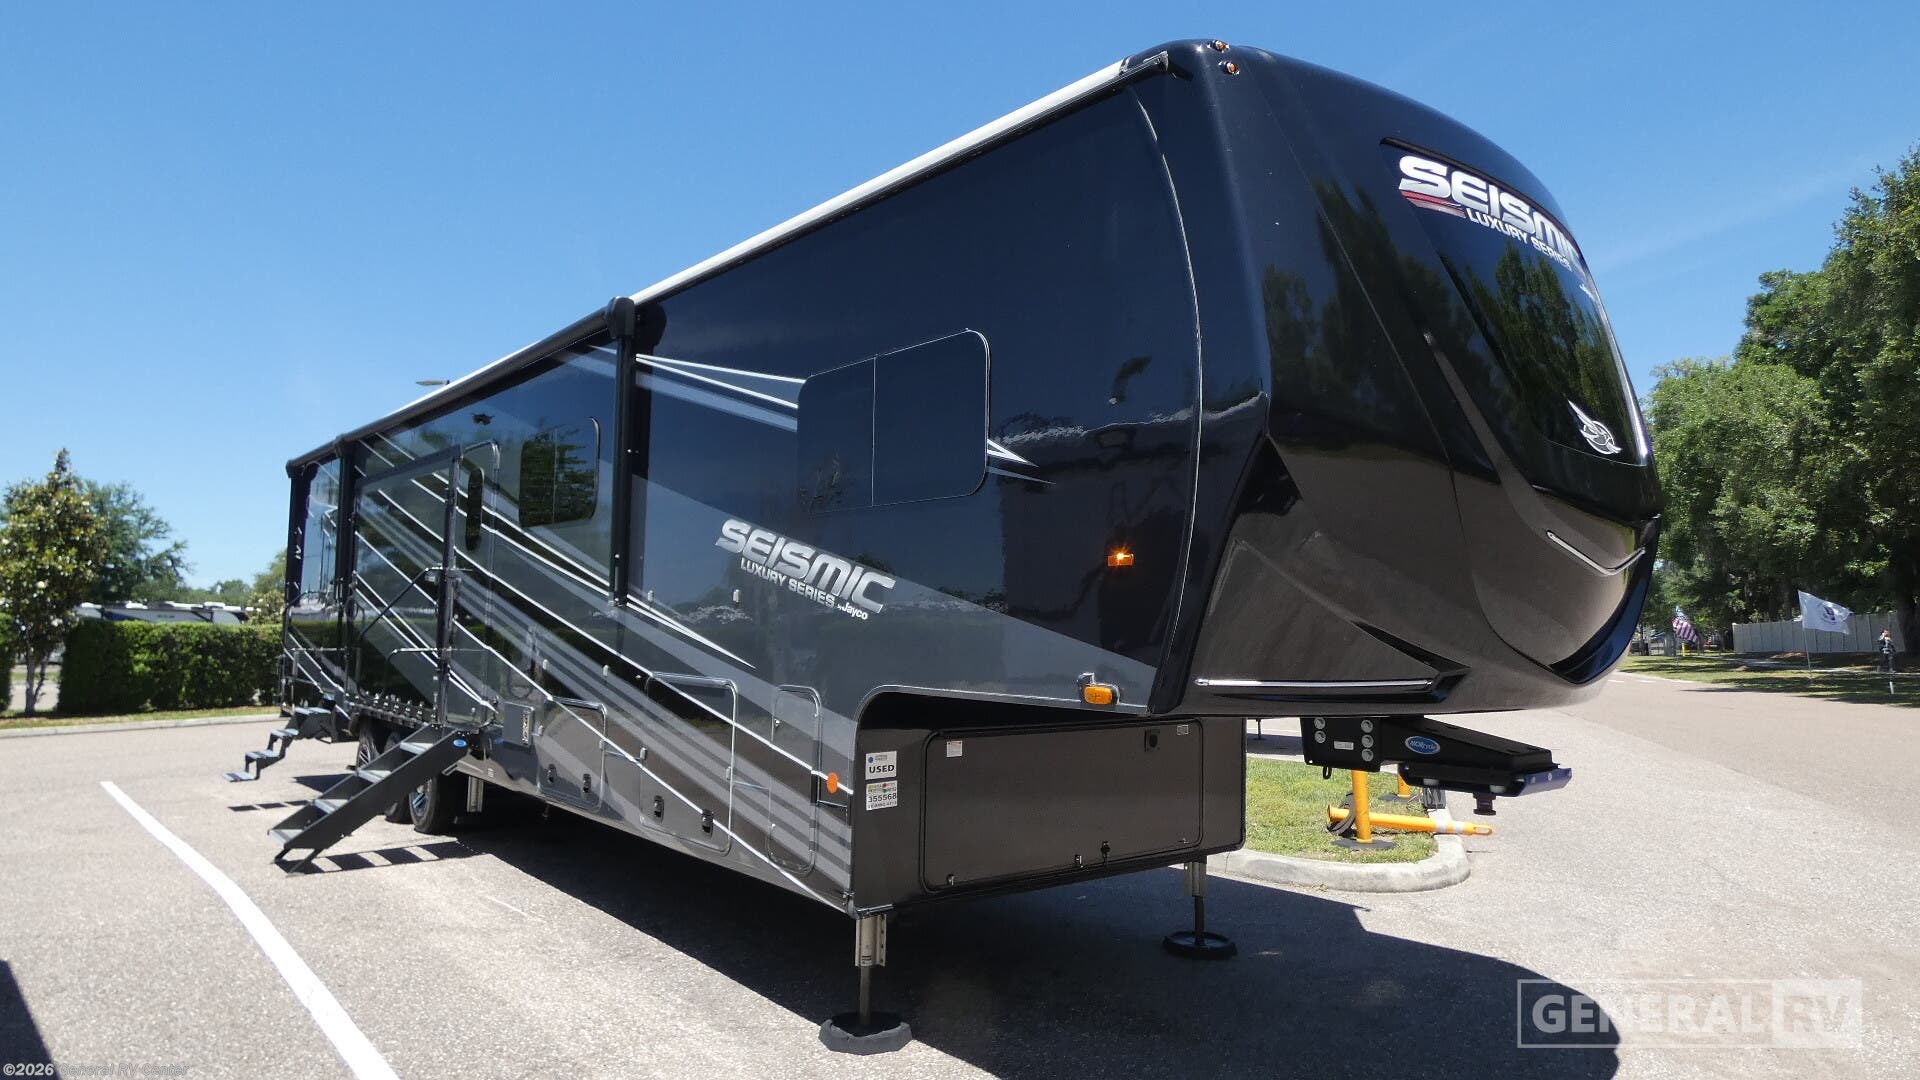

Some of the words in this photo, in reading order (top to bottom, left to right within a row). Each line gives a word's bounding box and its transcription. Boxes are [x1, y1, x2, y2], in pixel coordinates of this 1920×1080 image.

[1466, 208, 1528, 244] LUXURY
[715, 519, 896, 614] SEISMIC
[740, 557, 786, 587] LUXURY
[788, 578, 835, 608] SERIES
[869, 764, 895, 774] USED
[868, 792, 897, 803] 355568
